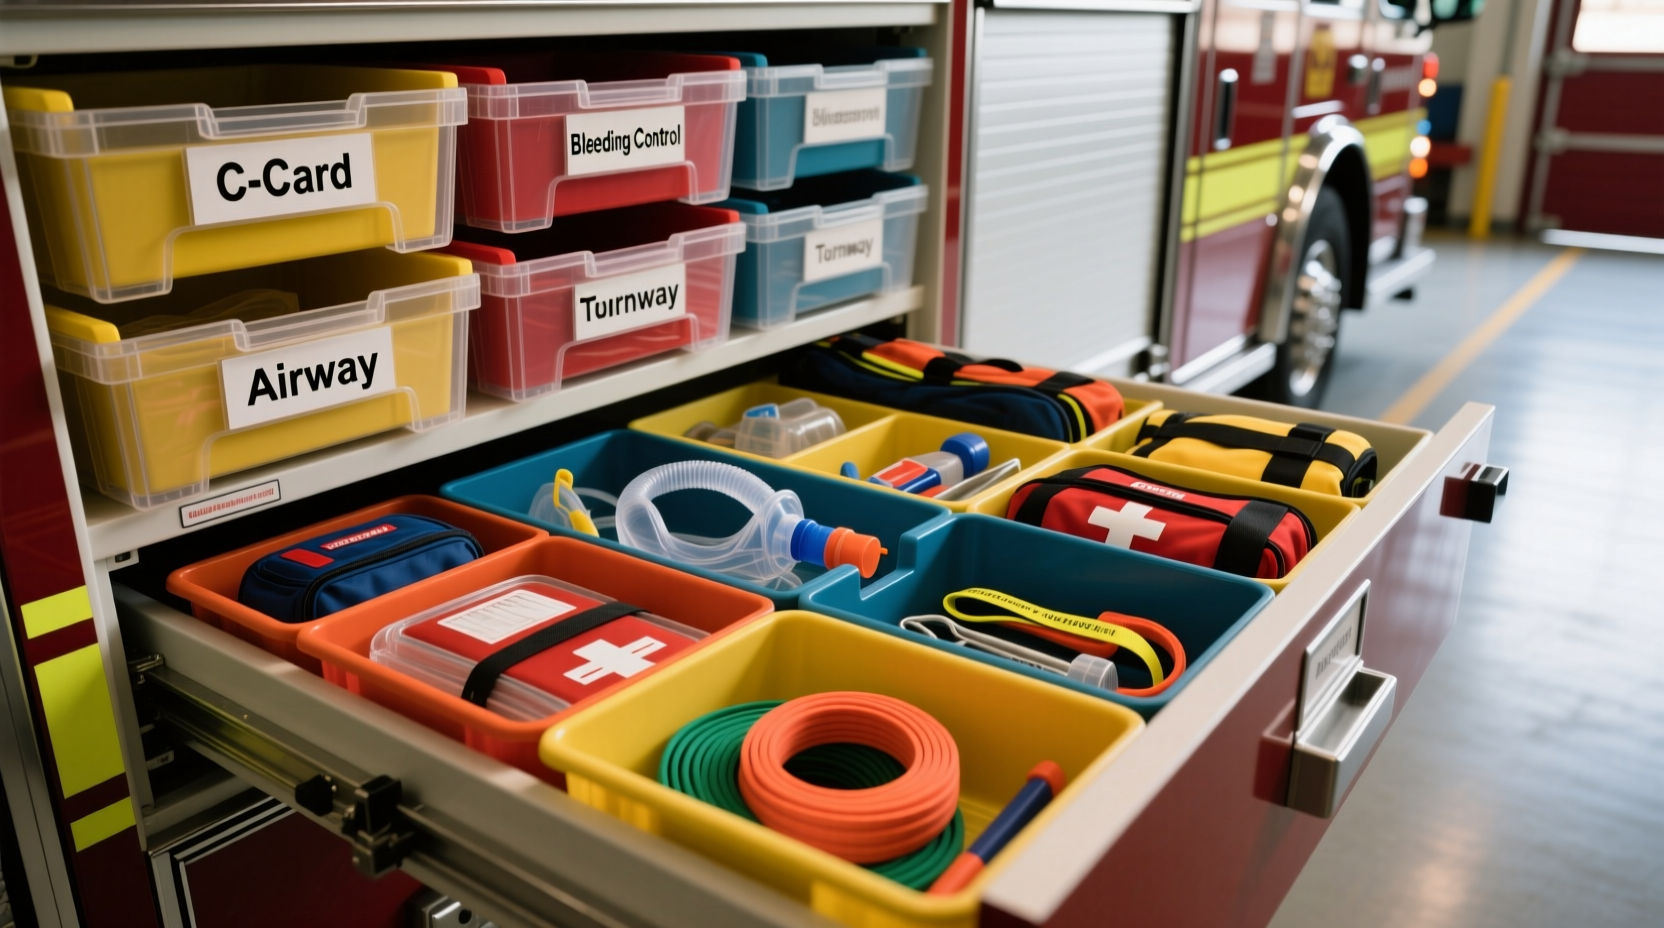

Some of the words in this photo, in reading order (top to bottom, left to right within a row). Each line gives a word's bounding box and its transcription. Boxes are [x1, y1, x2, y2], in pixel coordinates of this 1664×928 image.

[570, 129, 631, 156] Bleeding
[633, 123, 681, 149] Control
[216, 152, 352, 202] C-Card
[247, 352, 378, 406] Airway
